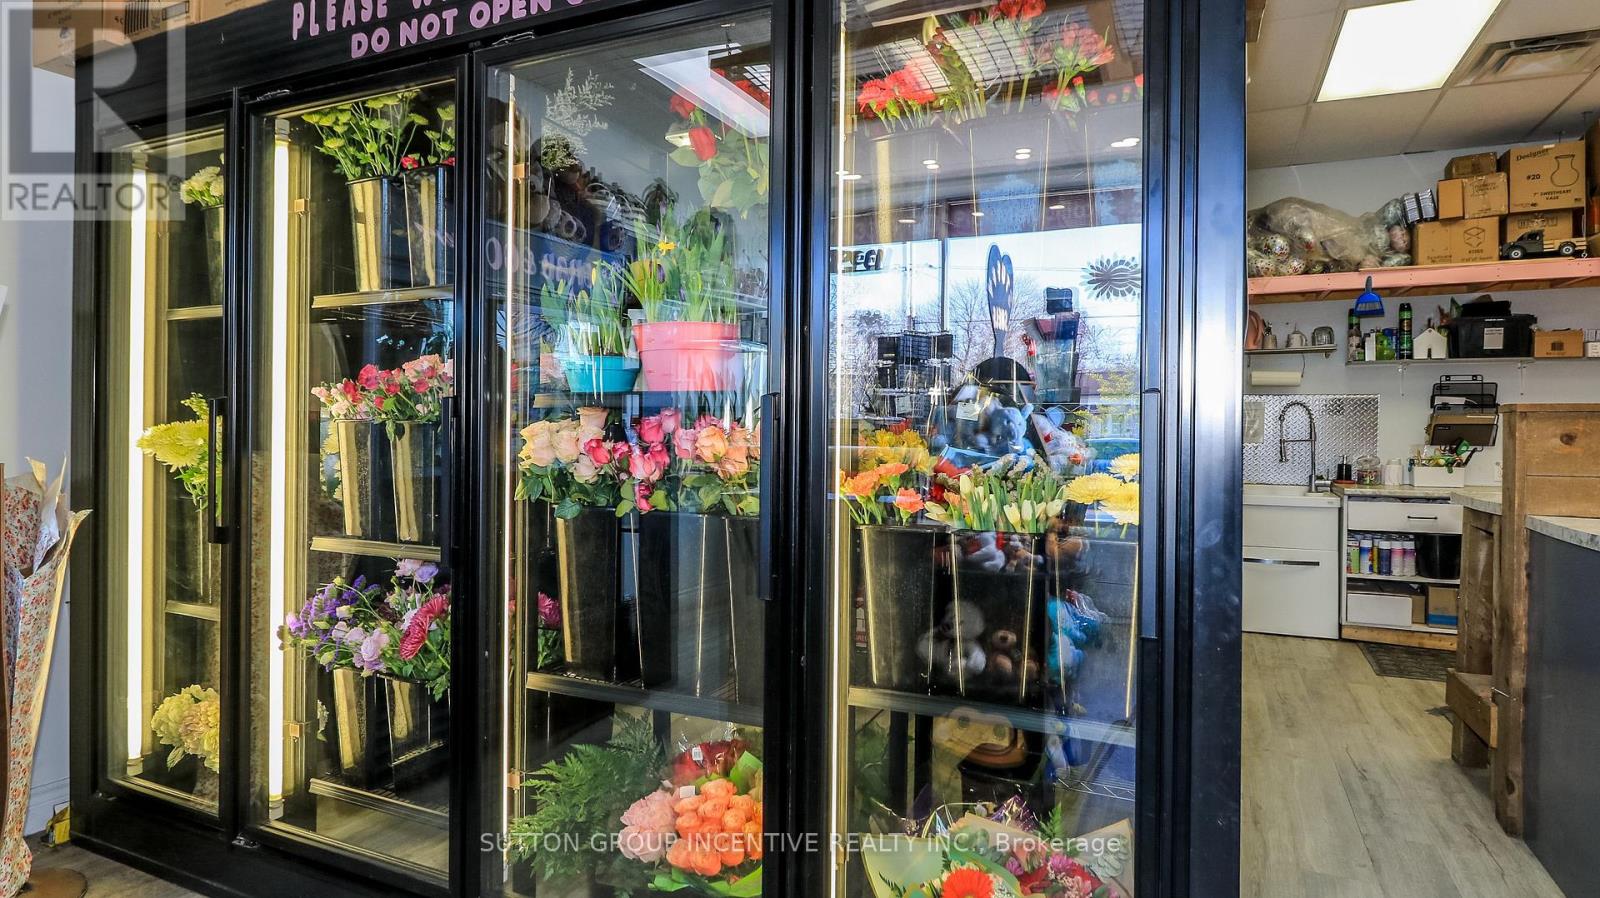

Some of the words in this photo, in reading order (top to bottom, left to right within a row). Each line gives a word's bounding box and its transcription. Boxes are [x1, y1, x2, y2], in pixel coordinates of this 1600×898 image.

[292, 0, 388, 41] PLEASE
[351, 27, 390, 59] DO
[400, 8, 458, 47] NOT
